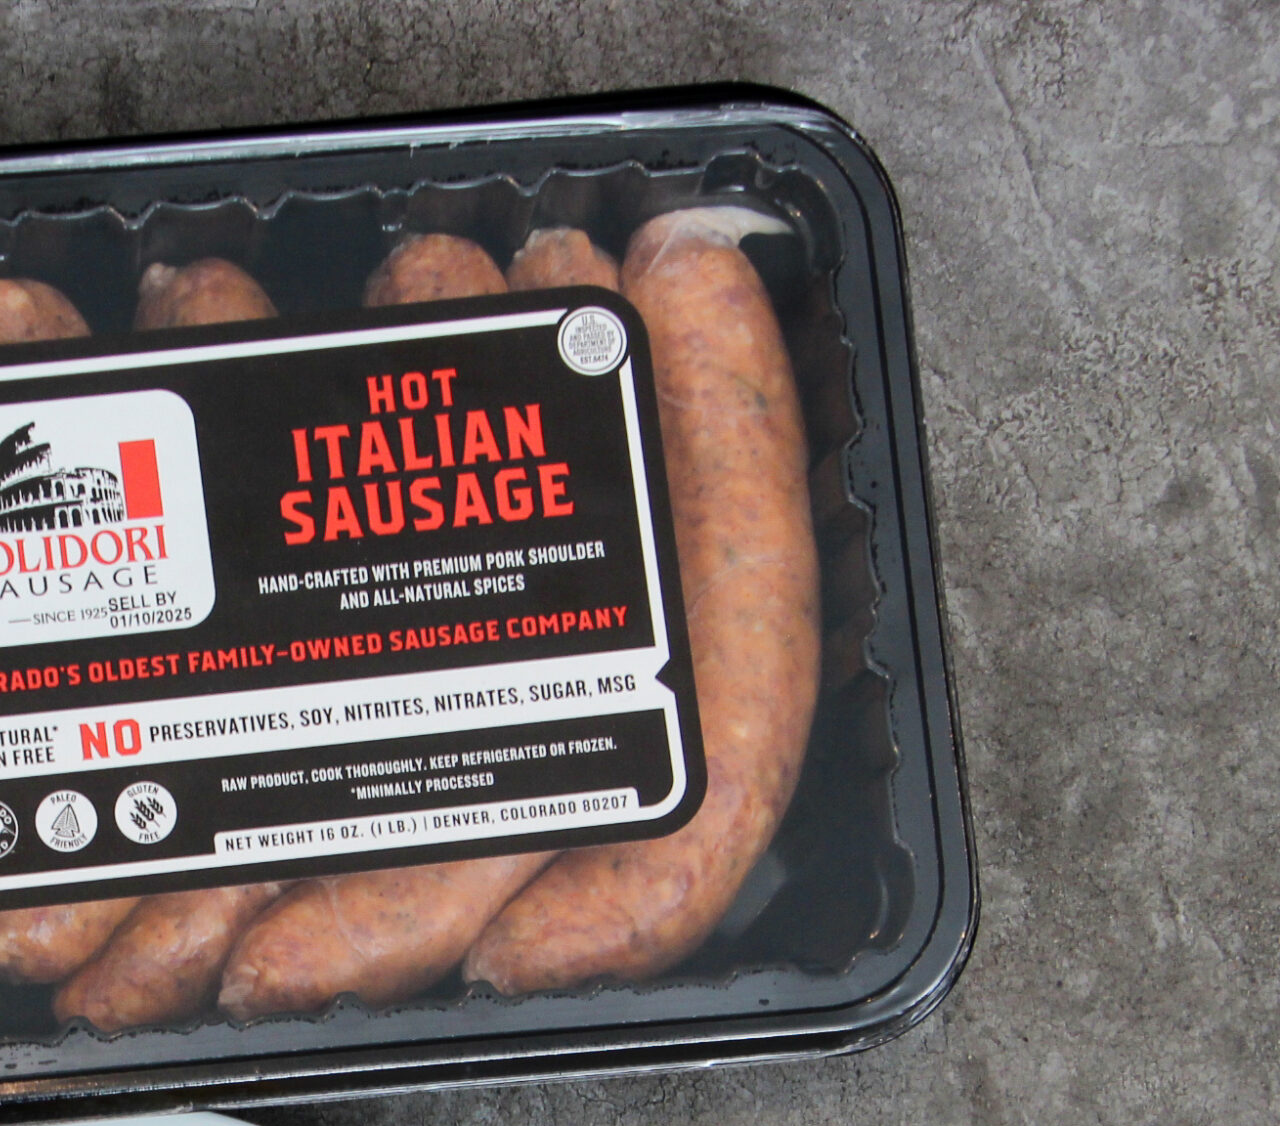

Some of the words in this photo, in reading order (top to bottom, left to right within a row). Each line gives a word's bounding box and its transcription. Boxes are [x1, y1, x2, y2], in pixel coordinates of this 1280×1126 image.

[366, 367, 458, 415] HOT
[291, 403, 547, 483] ITALIAN
[279, 461, 575, 546] SAUSAGE
[258, 566, 369, 595] HAND-CRAFTED
[372, 561, 410, 583] WITH
[413, 553, 483, 579] PREMIUM
[485, 549, 526, 571] PORK
[528, 540, 606, 566] SHOULDER
[107, 594, 152, 613] SELL
[156, 590, 177, 607] BY
[340, 590, 370, 611] AND
[373, 580, 471, 607] ALL-NATURAL
[473, 573, 526, 596] SPICES
[33, 609, 76, 626] SINCE
[80, 606, 109, 620] 1925
[109, 606, 193, 629] 01/10/2025
[87, 654, 181, 684] OLDEST
[187, 632, 384, 674] FAMILY-OWNED
[388, 620, 501, 653] SAUSAGE
[505, 605, 629, 639] COMPANY
[78, 718, 143, 761] NO
[149, 711, 296, 743] PRESERVATIVES,
[299, 706, 340, 727] SOY,
[344, 697, 430, 723] NITRITES,
[434, 687, 525, 713] NITRATES,
[528, 679, 593, 702] SUGAR,
[597, 673, 637, 695] MSG
[13, 746, 56, 766] FREE
[221, 777, 248, 793] RAW
[250, 770, 310, 790] PRODUCT.
[311, 766, 344, 783] COOK
[344, 757, 428, 779] THOROUGHLY.
[429, 754, 459, 771] KEEP
[462, 743, 548, 767] REFRIGERATED
[549, 741, 566, 756] OR
[568, 736, 618, 755] FROZEN.
[127, 784, 160, 798] GLUTEN
[425, 771, 495, 793] PROCESSED
[50, 793, 77, 805] PALEO
[138, 831, 161, 843] FREE
[224, 836, 253, 852] NET
[257, 829, 315, 848] WEIGHT
[320, 826, 336, 842] 16
[340, 824, 365, 840] OZ.
[387, 816, 417, 835] LB.)
[433, 810, 496, 830] DENVER,
[500, 801, 577, 822] COLORADO
[583, 795, 629, 813] 80207
[50, 832, 89, 849] FRIENDLY
